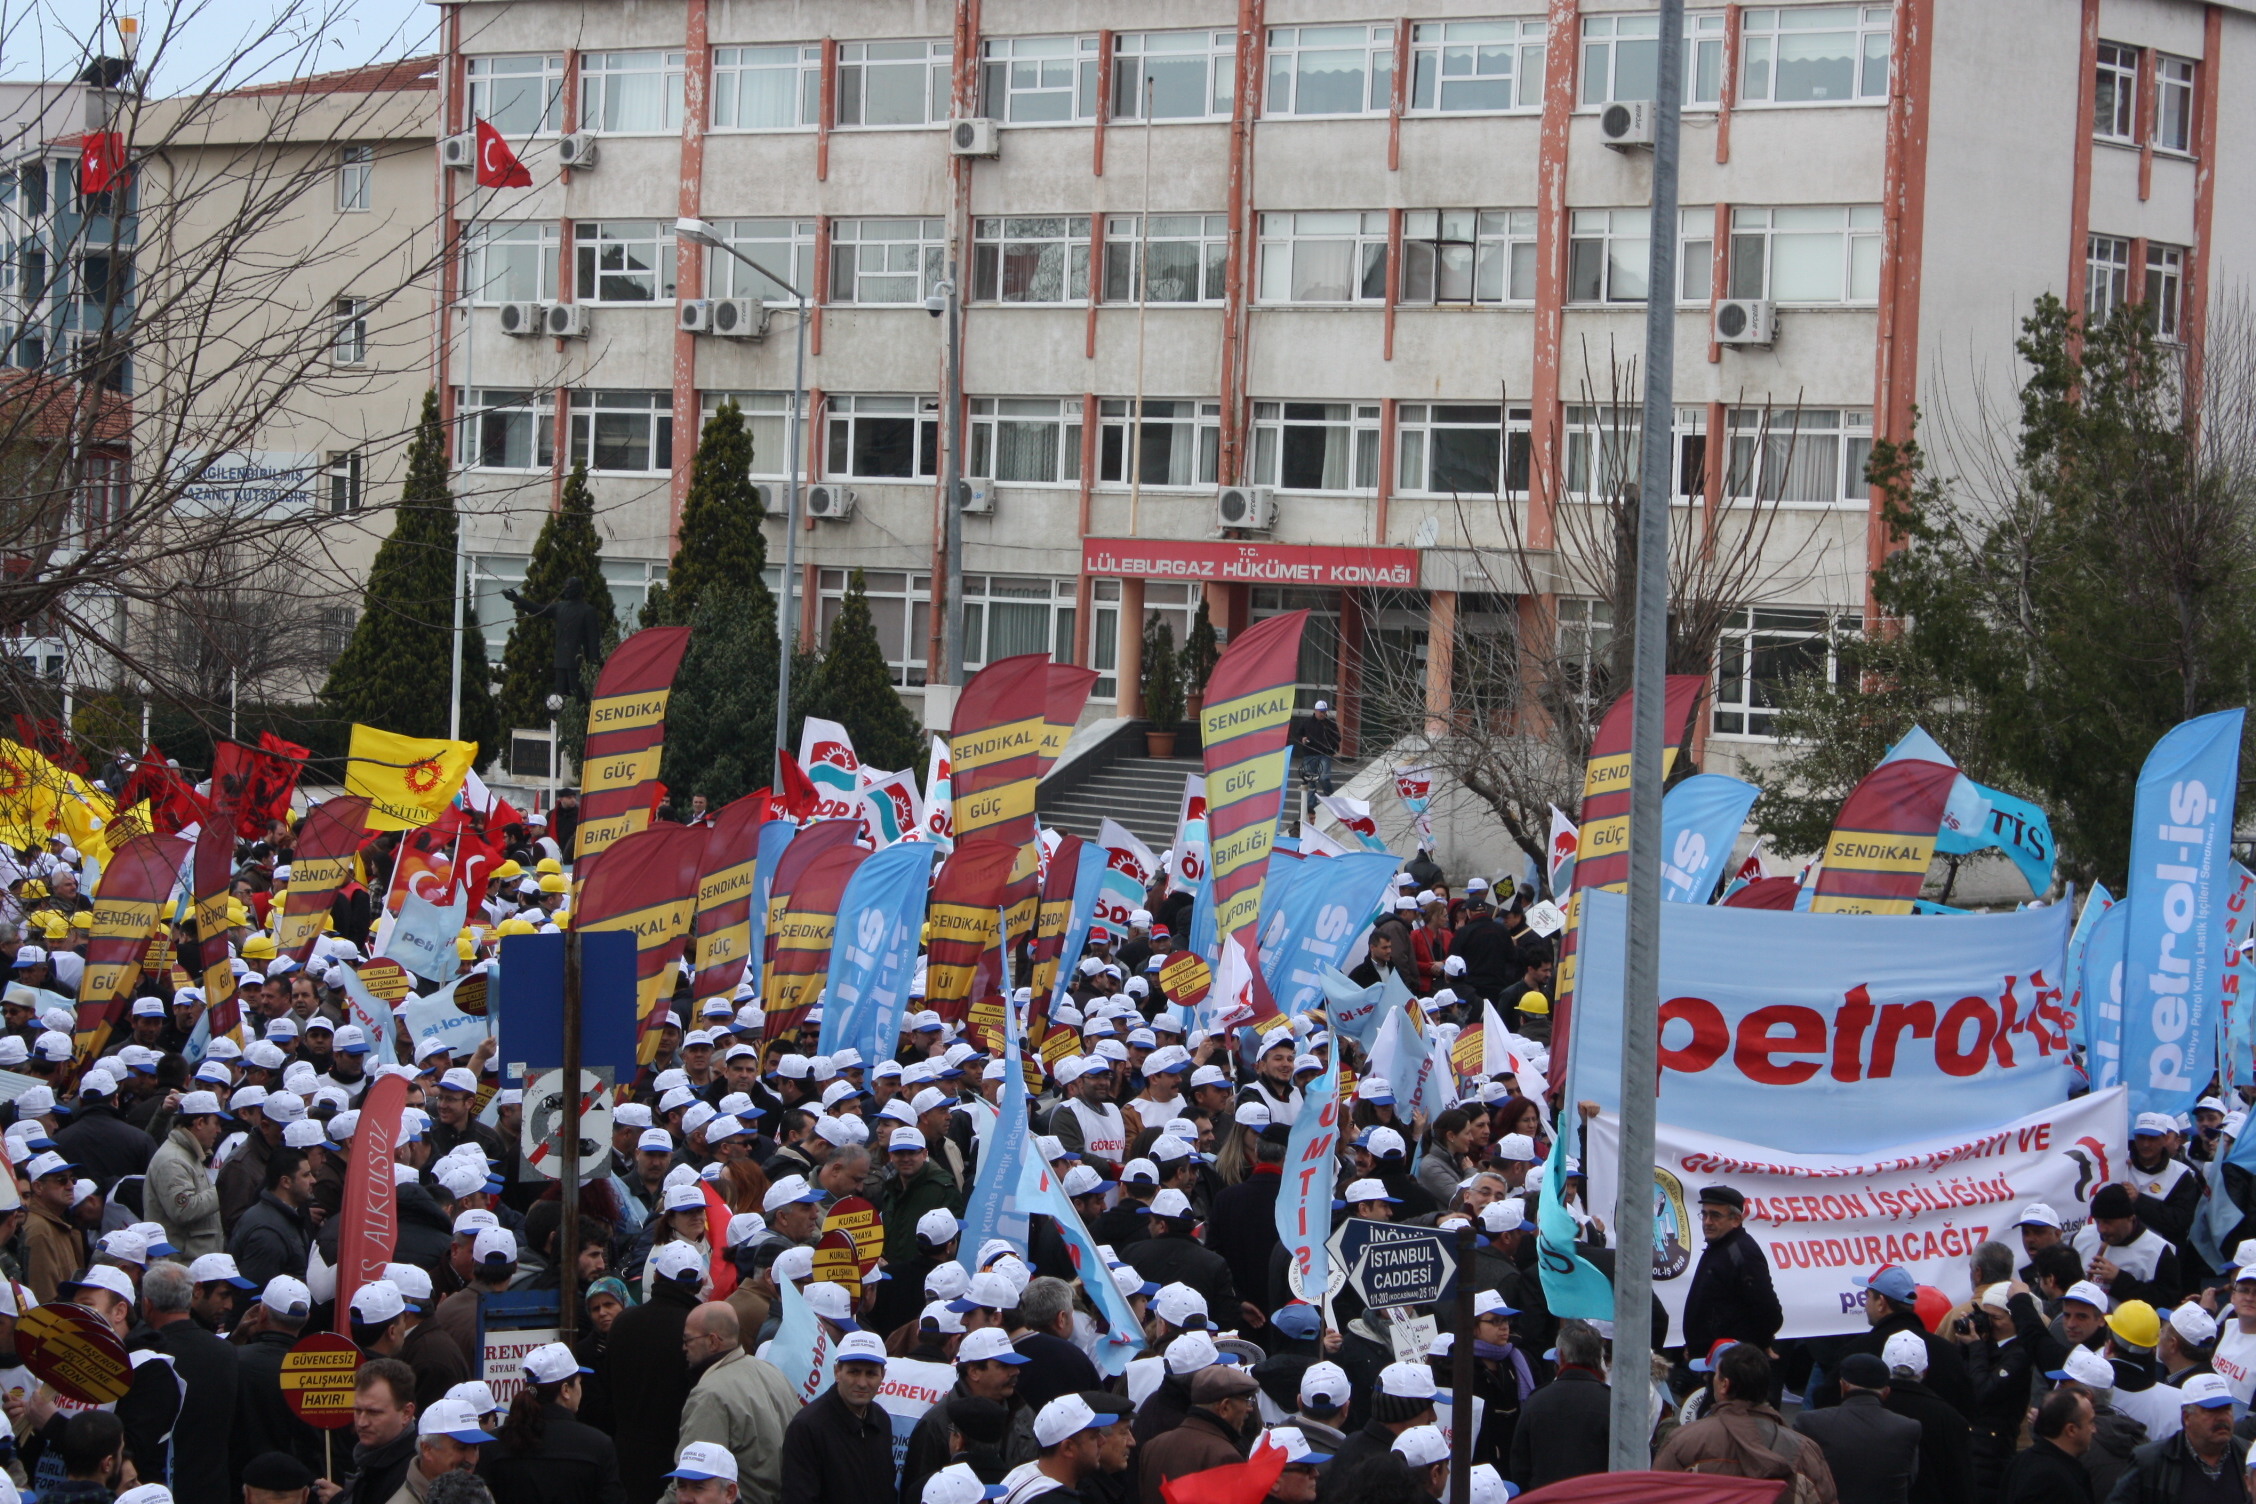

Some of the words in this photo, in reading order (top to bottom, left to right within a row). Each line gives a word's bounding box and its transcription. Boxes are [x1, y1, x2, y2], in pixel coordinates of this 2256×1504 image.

[1238, 547, 1259, 557] T.C.
[1087, 552, 1215, 576] LÜLEBURGAZ
[1222, 558, 1323, 581] HÜKÜMET
[1330, 563, 1411, 584] KONAĞI
[1208, 697, 1289, 733] SENDİKAL
[954, 730, 1034, 762] SENDİKAL
[602, 760, 638, 781] GÜÇ
[1225, 769, 1256, 793] GÜÇ
[970, 797, 1002, 819] GÜÇ
[584, 819, 631, 845] BİRLİ
[1593, 825, 1626, 846] GÜÇ
[1215, 830, 1268, 866] BİRLİĞİ
[1832, 842, 1923, 862] SENDİKAL
[2200, 822, 2216, 879] Sendikası
[290, 866, 344, 883] SENDİKA
[700, 872, 752, 901] SENDİKAL
[2197, 878, 2211, 921] İşçileri
[92, 911, 152, 927] SENDİKA
[780, 923, 834, 940] SEDİKA
[2149, 779, 2217, 1092] petrol-iş
[2195, 921, 2208, 956] Lastik
[707, 937, 731, 957] GÜÇ
[369, 967, 399, 977] KURALSIZ
[1169, 957, 1194, 974] TAŞERON
[2193, 956, 2207, 990] Kimya
[365, 979, 399, 989] ÇALIŞMAYA
[1170, 967, 1199, 988] İŞÇİLİĞİNE
[1178, 981, 1196, 996] SON!
[470, 1001, 486, 1010] HAY
[2191, 991, 2203, 1026] Petrol
[1455, 1030, 1484, 1050] GÜVENCES
[1463, 1053, 1483, 1067] HAYIR
[2017, 1122, 2052, 1153] VE
[363, 1118, 390, 1251] ALKOLSÜZ
[1742, 1192, 1869, 1228] TAŞERON
[1867, 1170, 2016, 1222] İŞÇİLİĞİNİ
[837, 1212, 872, 1227] KURALSIZ
[1369, 1225, 1425, 1243] İNÖ
[1768, 1221, 1990, 1270] DURDURACAĞIZ
[1370, 1245, 1435, 1269] İSTANBUL
[1672, 1255, 1685, 1272] 1950
[1374, 1264, 1432, 1290] CADDESİ
[1419, 1287, 1428, 1299] 2/5
[80, 1343, 122, 1373] TAŞERON
[292, 1351, 354, 1366] GÜVENCESİZ
[484, 1343, 547, 1361] RENK
[56, 1364, 89, 1386] SON!
[61, 1349, 113, 1384] İŞÇİLİĞİNE
[489, 1362, 516, 1374] SİYAH
[299, 1375, 355, 1388] ÇALIŞMAYA
[304, 1393, 345, 1406] HAYIR!
